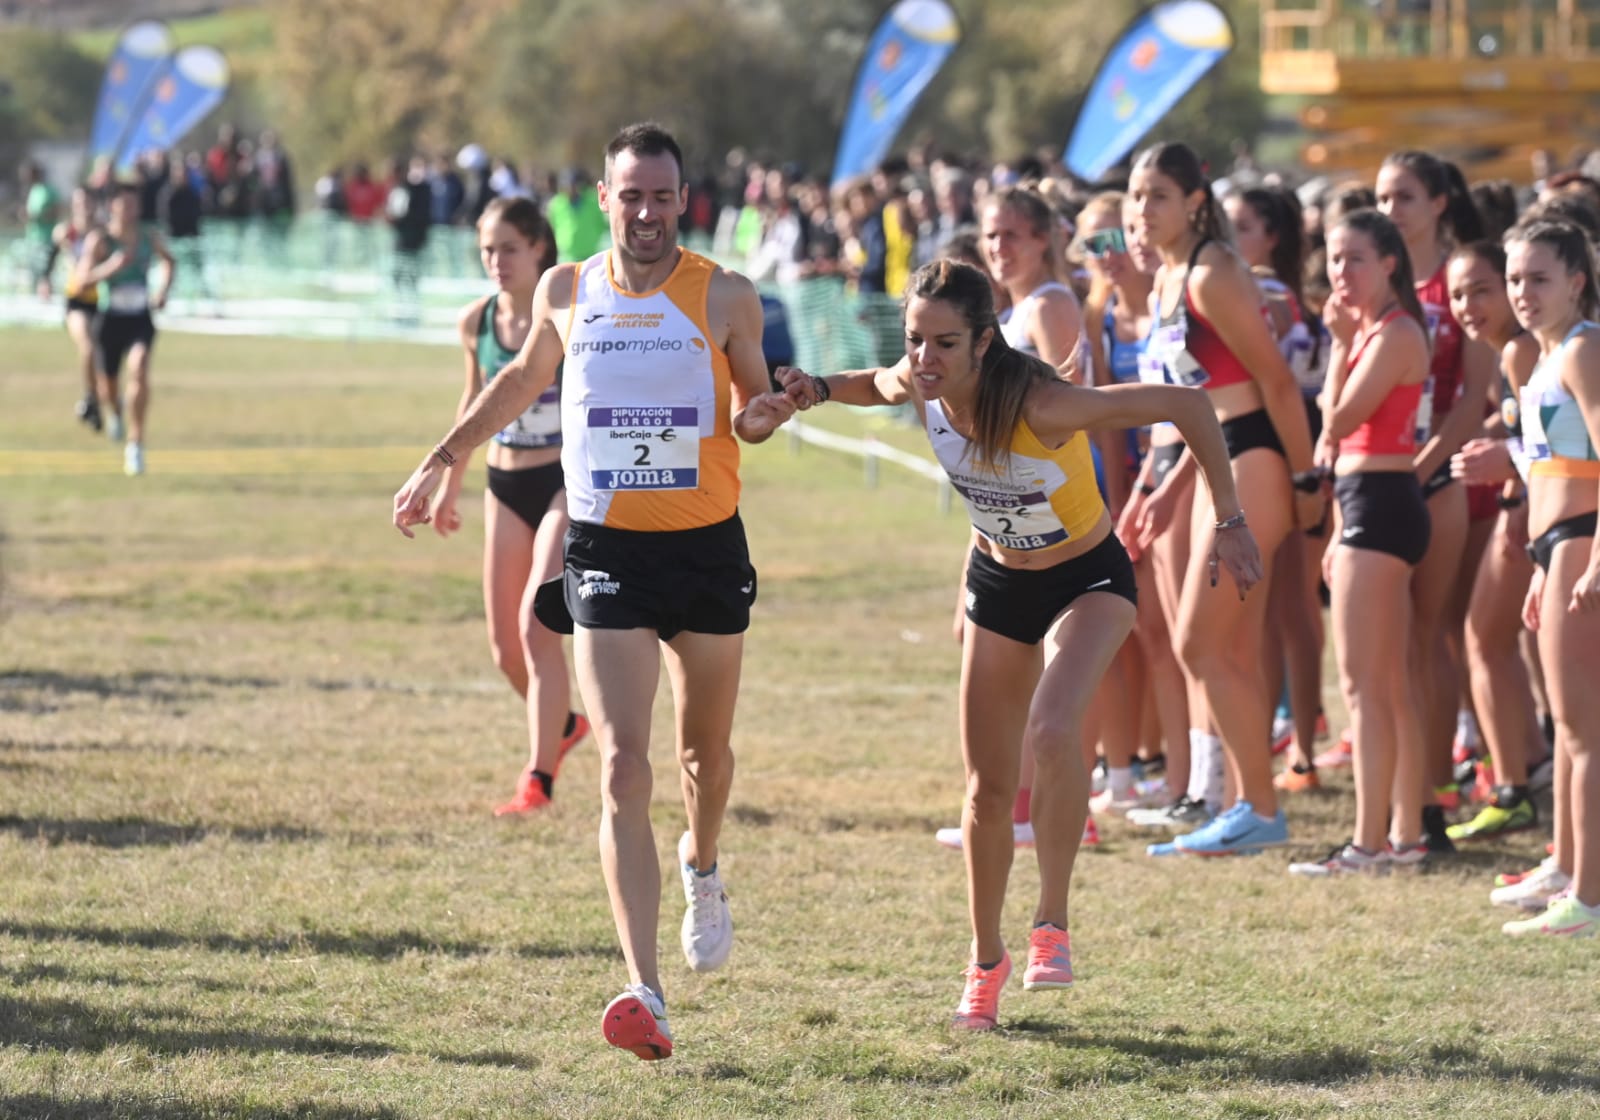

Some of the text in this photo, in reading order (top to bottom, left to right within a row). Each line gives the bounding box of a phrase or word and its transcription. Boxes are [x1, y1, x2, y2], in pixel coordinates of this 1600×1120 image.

[571, 336, 683, 356] grupompleo
[611, 408, 673, 417] DIPUTACIÓN
[611, 417, 673, 426] BURGOS
[609, 430, 652, 440] iberCaja
[633, 444, 651, 466] 2
[997, 517, 1017, 535] 2
[991, 534, 1047, 549] oma
